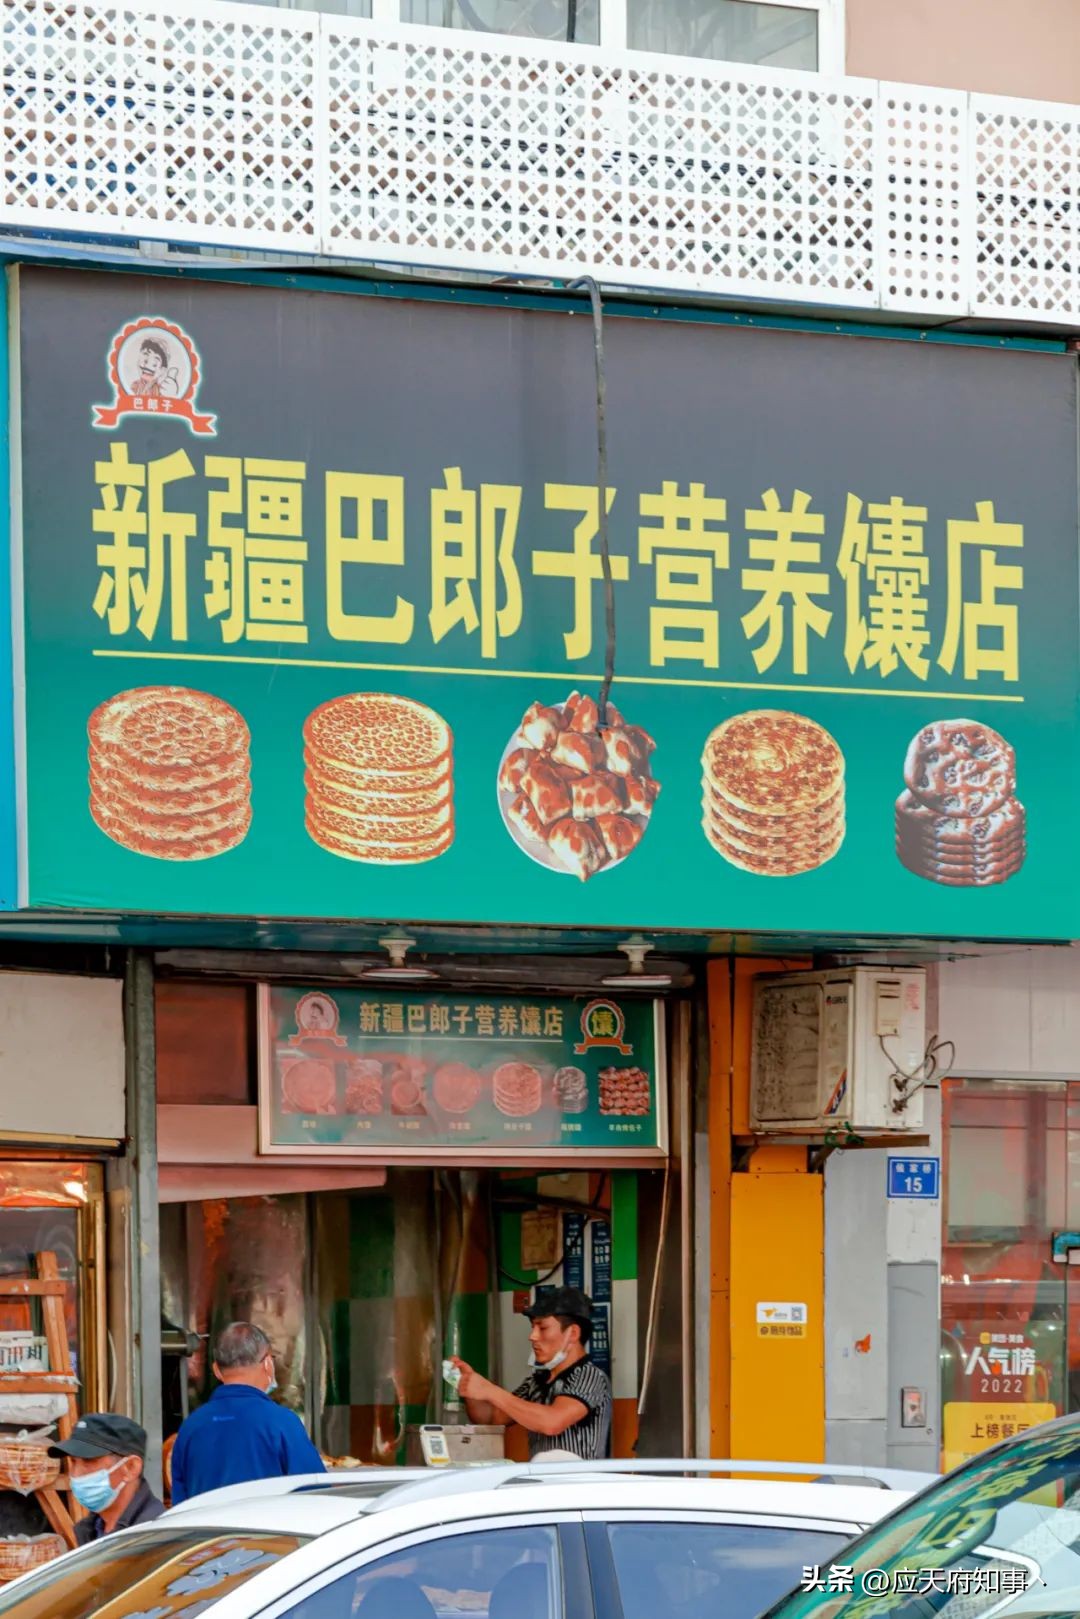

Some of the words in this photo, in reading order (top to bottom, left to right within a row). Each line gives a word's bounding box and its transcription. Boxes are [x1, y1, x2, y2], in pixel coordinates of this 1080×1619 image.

[133, 397, 174, 413] 巴郎子
[91, 441, 1025, 683] 新疆巴郎子营养馕店
[359, 1001, 564, 1037] 新疆巴郎子营养馕店
[904, 1176, 923, 1193] 15
[964, 1346, 1036, 1376] 人气榜
[981, 1379, 1023, 1393] 2022
